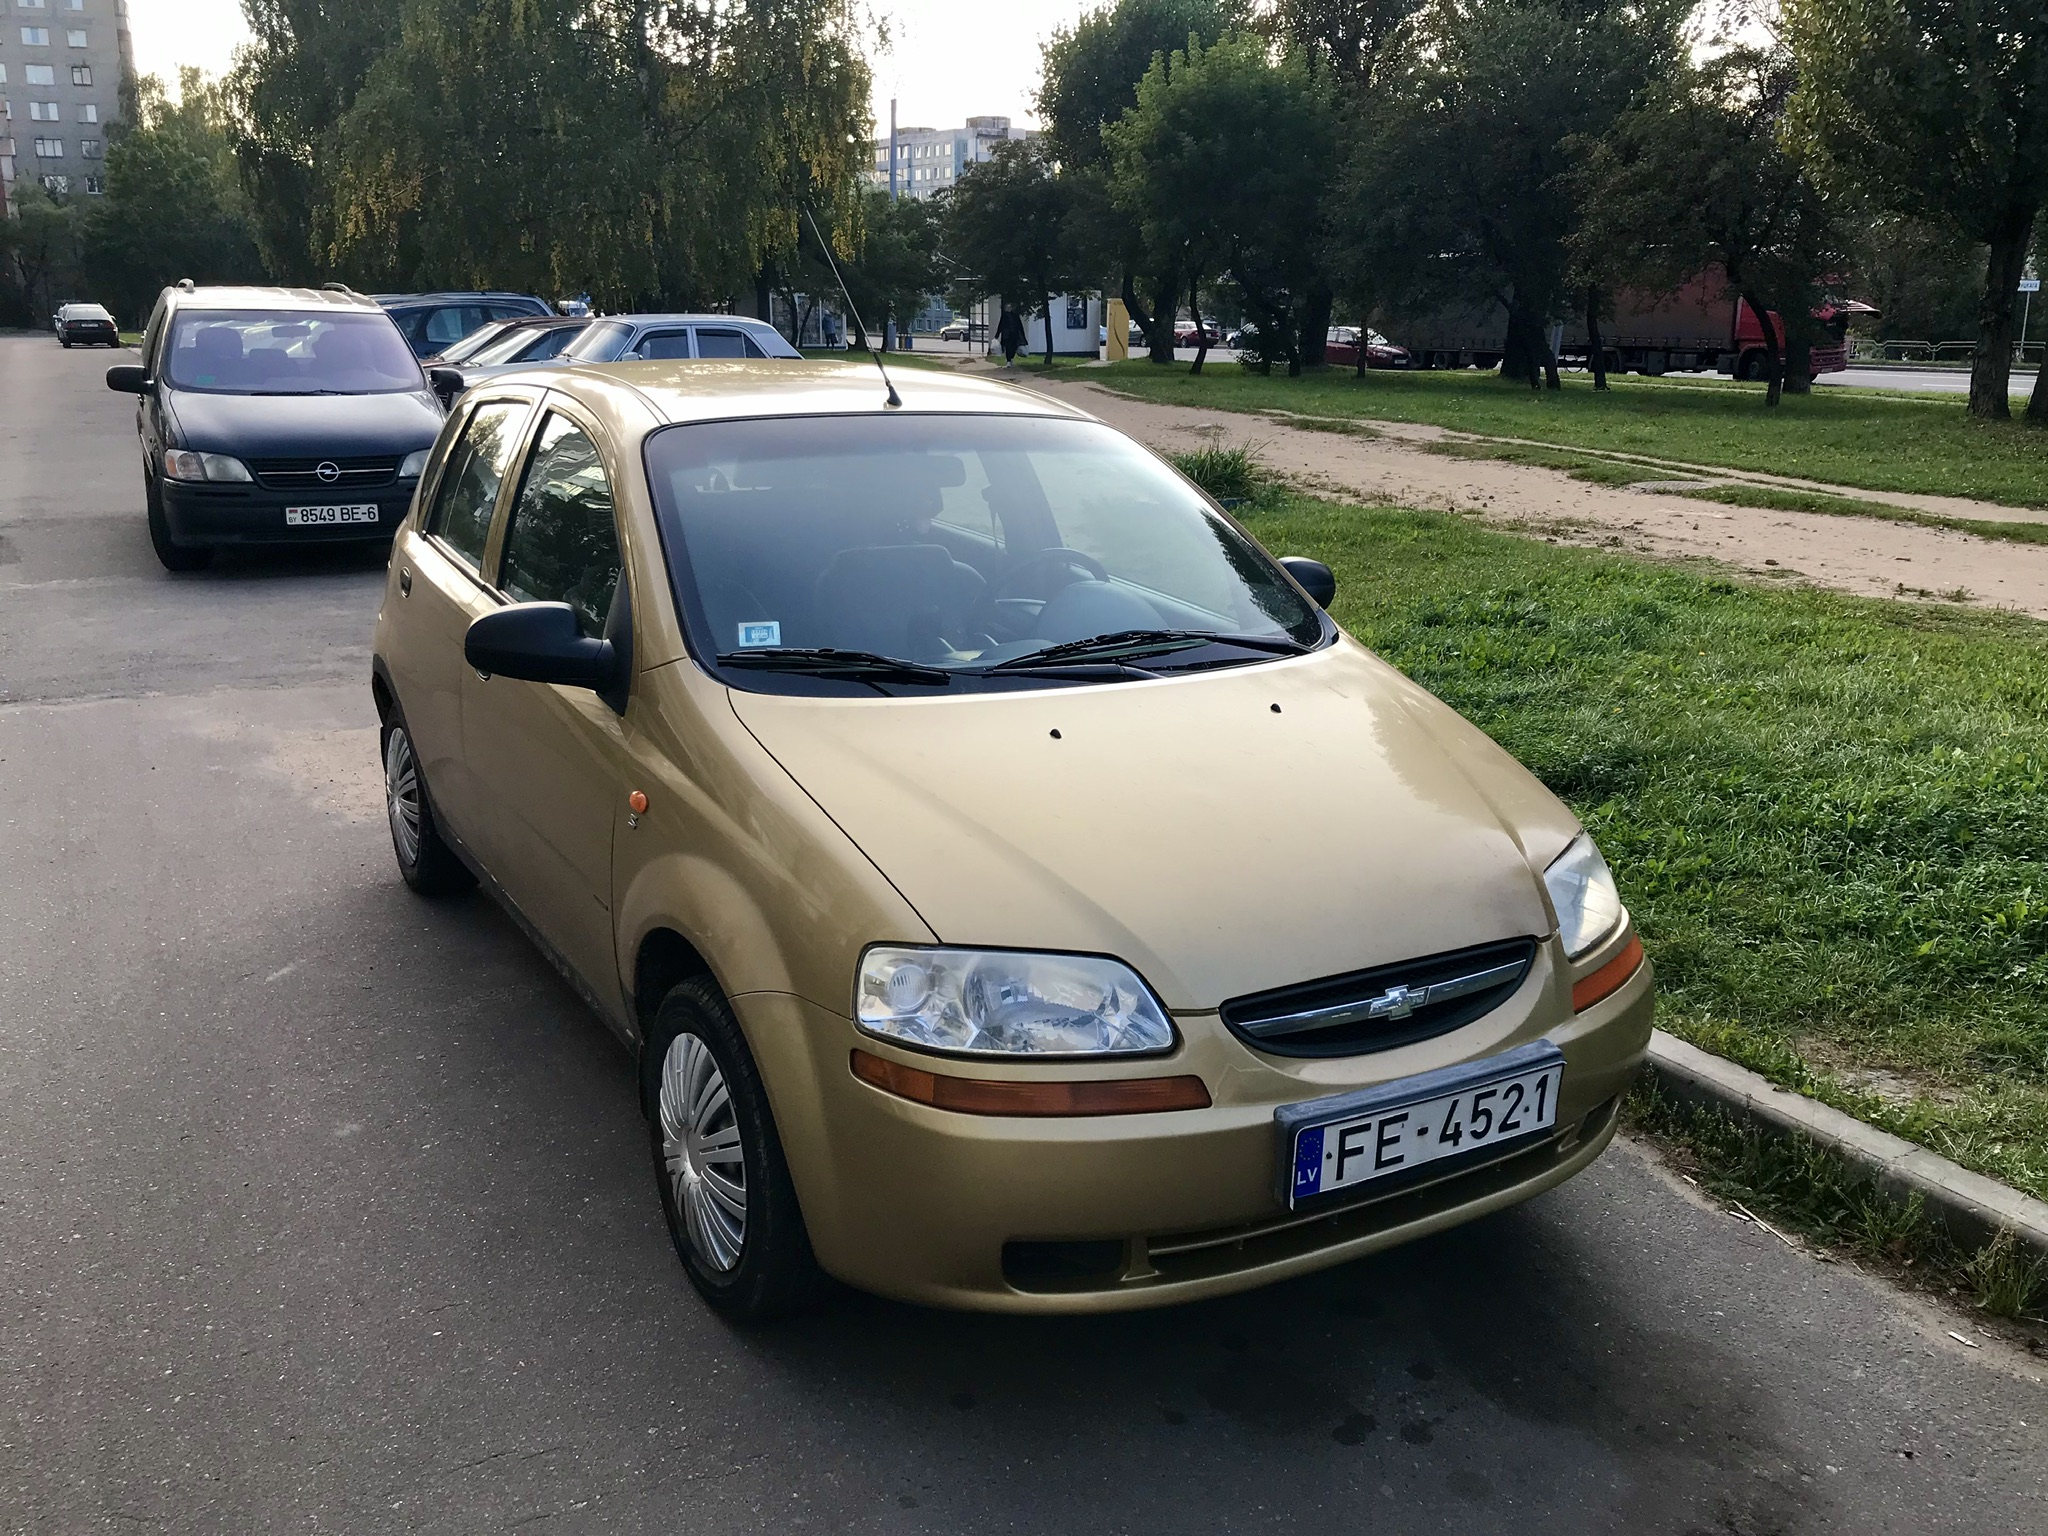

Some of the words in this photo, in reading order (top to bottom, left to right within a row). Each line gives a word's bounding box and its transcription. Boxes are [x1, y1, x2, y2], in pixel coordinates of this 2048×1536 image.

[300, 508, 336, 523] 8549
[340, 506, 376, 522] BE-6
[1296, 1166, 1318, 1186] LV
